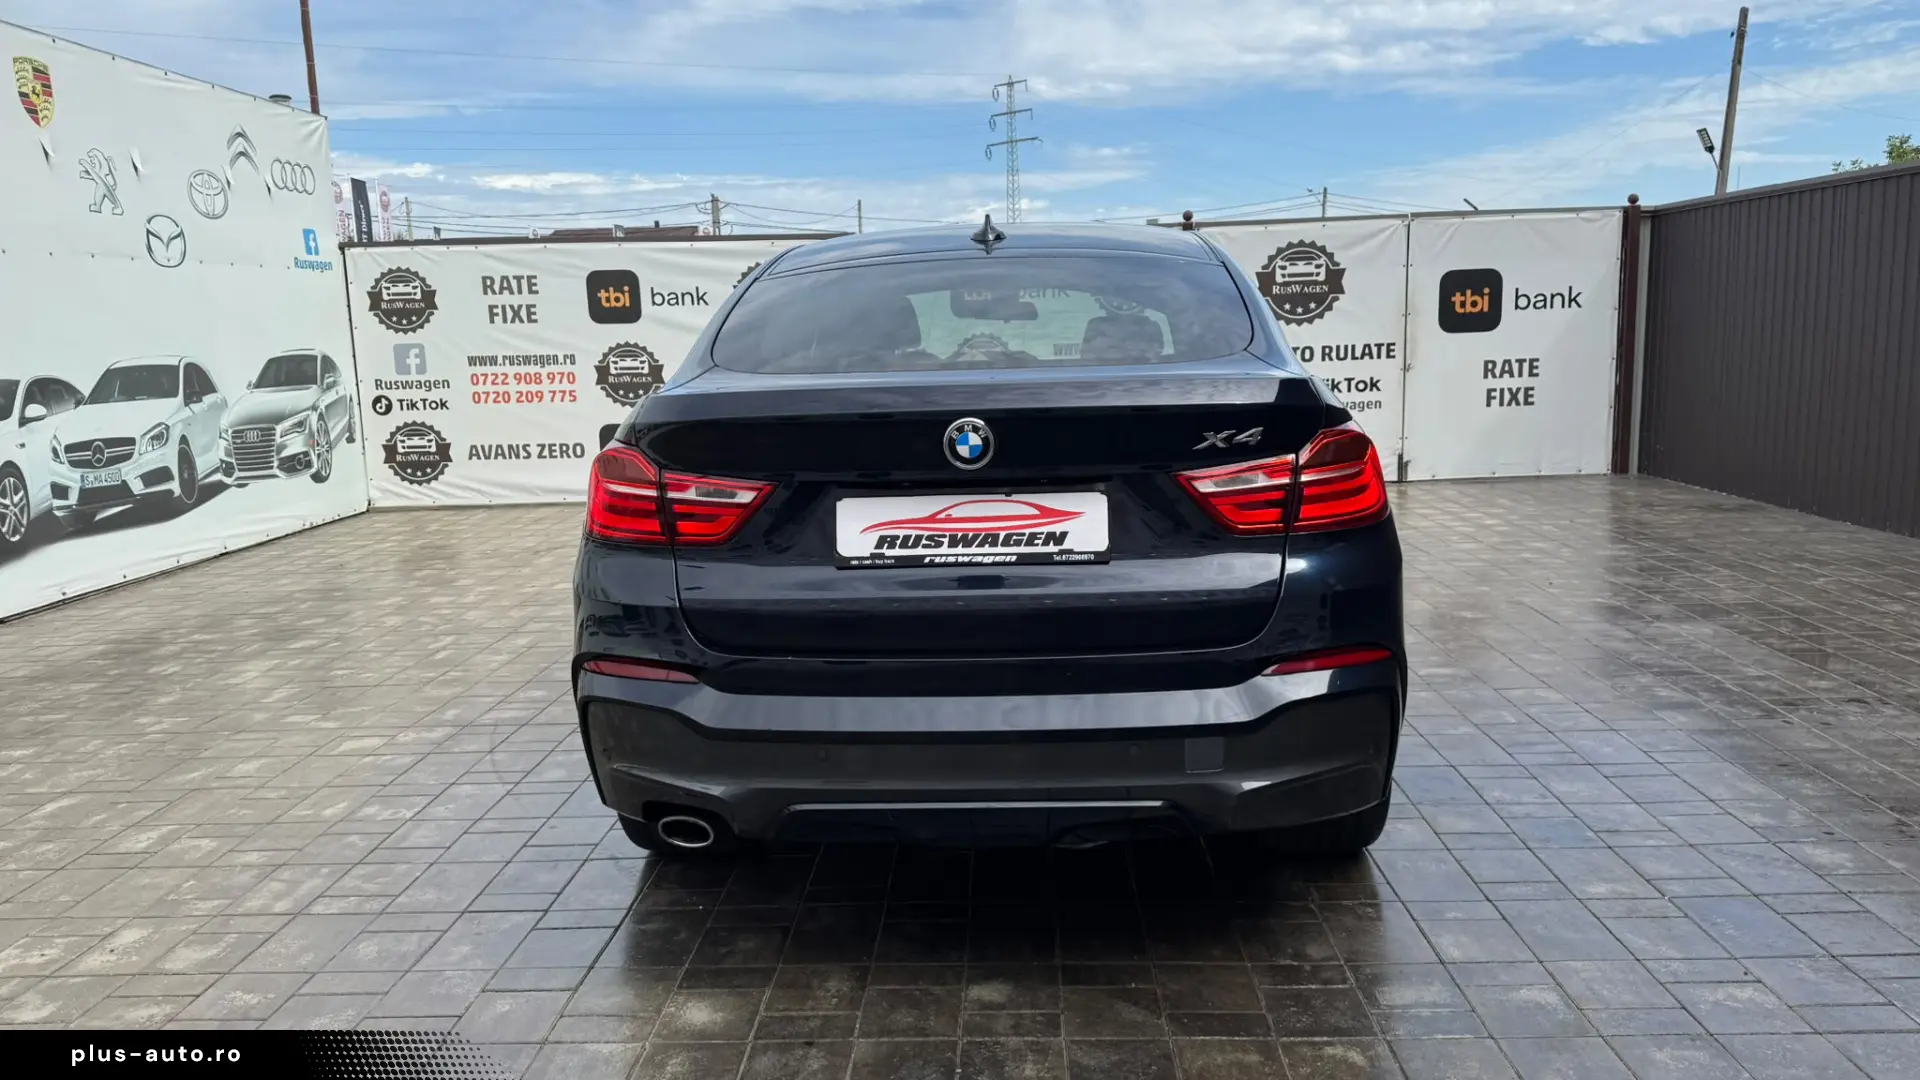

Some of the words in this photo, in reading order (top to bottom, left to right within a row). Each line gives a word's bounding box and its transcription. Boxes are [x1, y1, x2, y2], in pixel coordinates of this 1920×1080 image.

[294, 256, 333, 273] Ruswagen
[481, 275, 540, 296] RATE
[597, 286, 631, 309] tbi
[650, 286, 709, 307] bank
[1451, 287, 1491, 314] tbi
[1515, 286, 1583, 311] bank
[488, 303, 539, 325] FIXE
[467, 354, 576, 369] www.ruswagen.ro
[1291, 345, 1315, 363] TO
[1321, 342, 1396, 362] RULATE
[1482, 357, 1540, 380] RATE
[374, 379, 450, 392] Ruswagen
[470, 372, 510, 386] 0722
[513, 371, 543, 385] 908
[546, 371, 576, 385] 970
[1322, 376, 1382, 393] ikTok
[396, 398, 450, 411] TikTok
[472, 390, 512, 404] 0720
[515, 390, 544, 404] 209
[548, 389, 577, 403] 775
[1486, 386, 1536, 408] FIXE
[1343, 400, 1382, 412] agen
[950, 424, 987, 440] BMW
[1192, 426, 1264, 450] X4
[468, 443, 532, 461] AVANS
[536, 442, 586, 460] ZERO
[874, 530, 1069, 551] RUSWAGEN
[923, 554, 1017, 564] ruswagen
